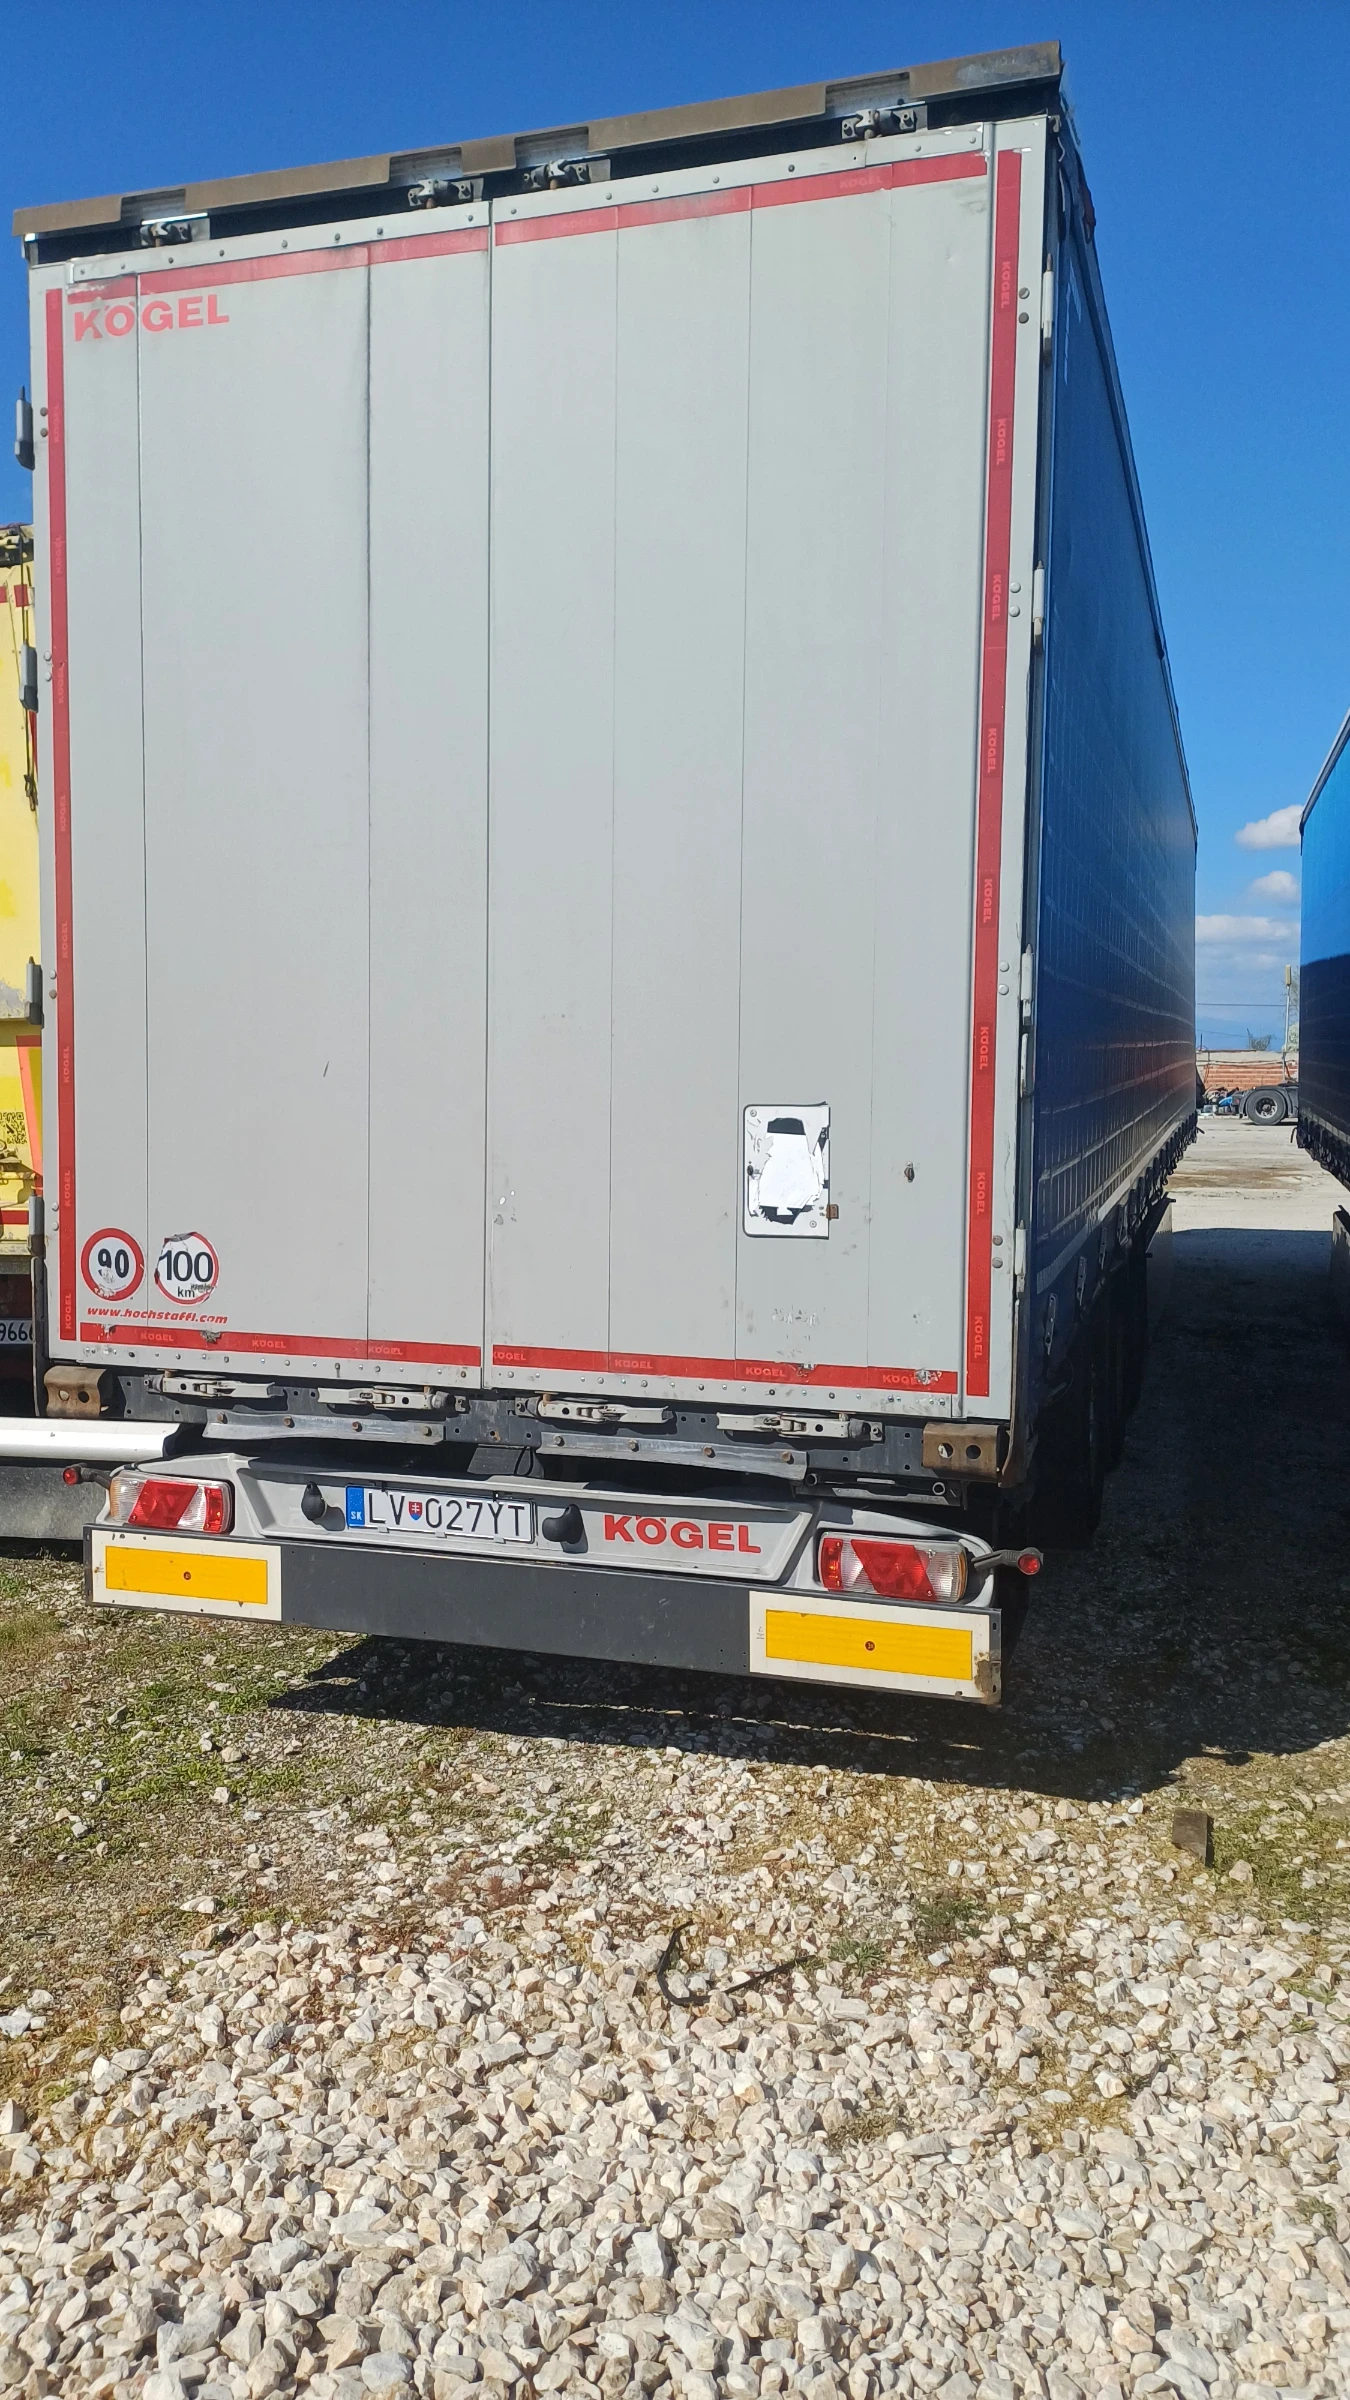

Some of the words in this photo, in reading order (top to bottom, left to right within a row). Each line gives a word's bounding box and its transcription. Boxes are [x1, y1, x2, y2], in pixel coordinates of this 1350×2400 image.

[74, 293, 230, 342] KÖGEL
[97, 1248, 129, 1278] 90
[159, 1249, 214, 1282] 100
[87, 1306, 228, 1324] www.hochstaffl.com
[350, 1510, 363, 1521] SK
[604, 1514, 762, 1554] KÖGEL
